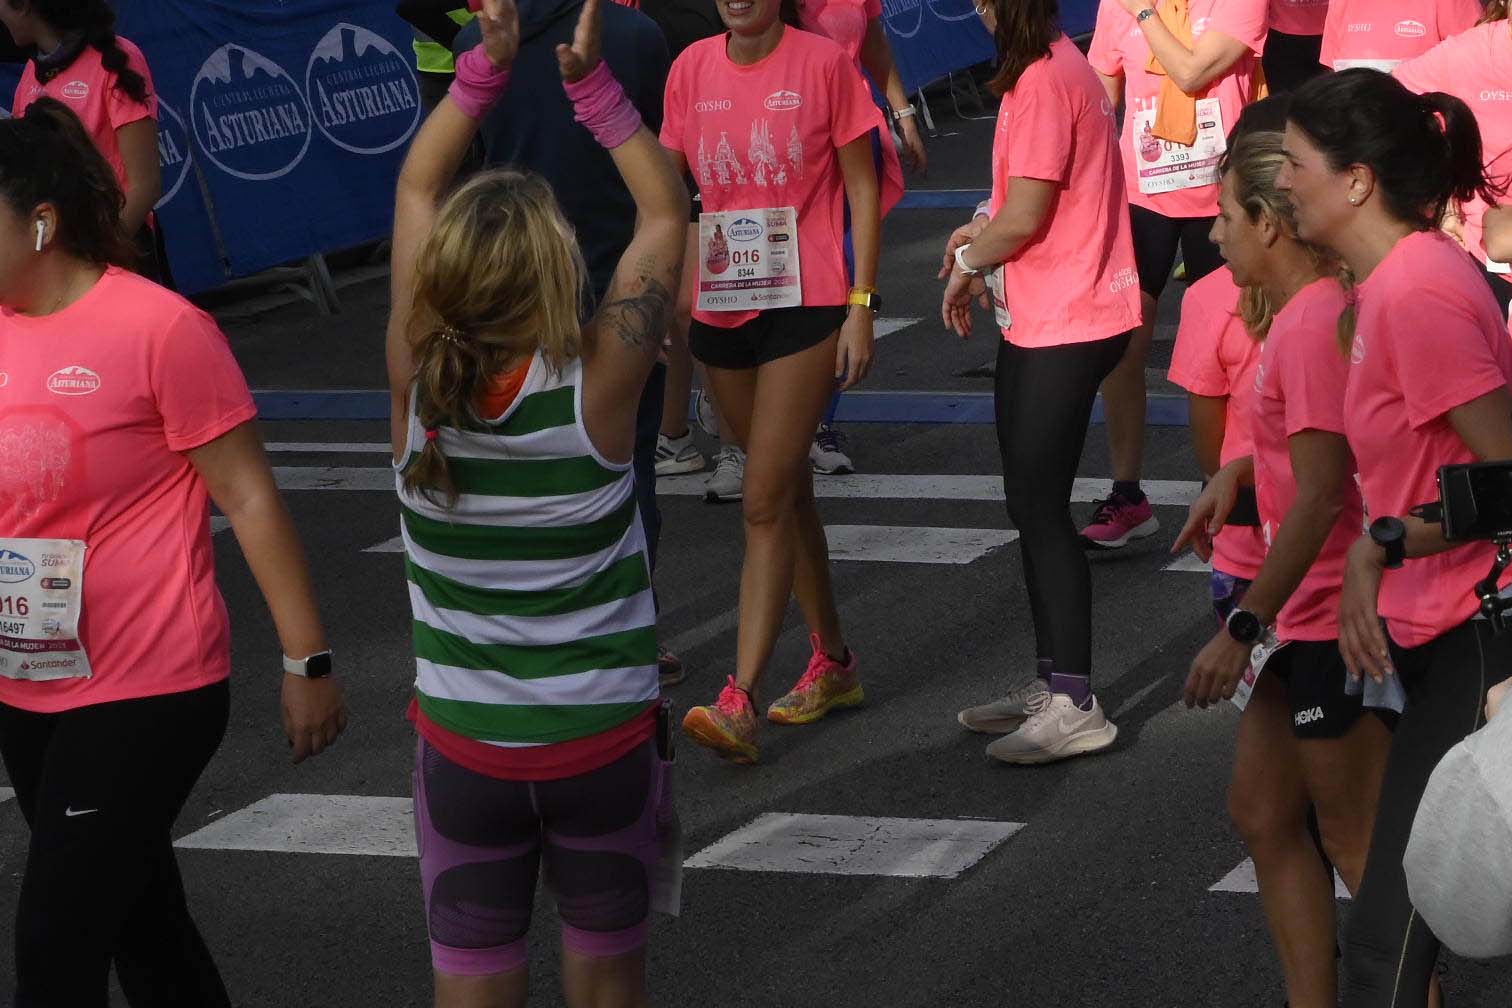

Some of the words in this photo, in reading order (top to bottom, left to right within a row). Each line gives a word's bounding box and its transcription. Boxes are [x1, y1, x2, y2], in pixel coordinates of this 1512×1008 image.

[316, 77, 417, 128] ASTURIANA
[695, 99, 732, 112] OYSHO
[204, 99, 306, 153] ASTURIANA
[1170, 153, 1190, 162] 3393
[732, 249, 760, 264] 016
[738, 268, 755, 277] 8344
[707, 296, 738, 305] OYSHO
[0, 595, 29, 615] 16
[30, 657, 77, 670] Santander
[1295, 706, 1323, 727] HOKA
